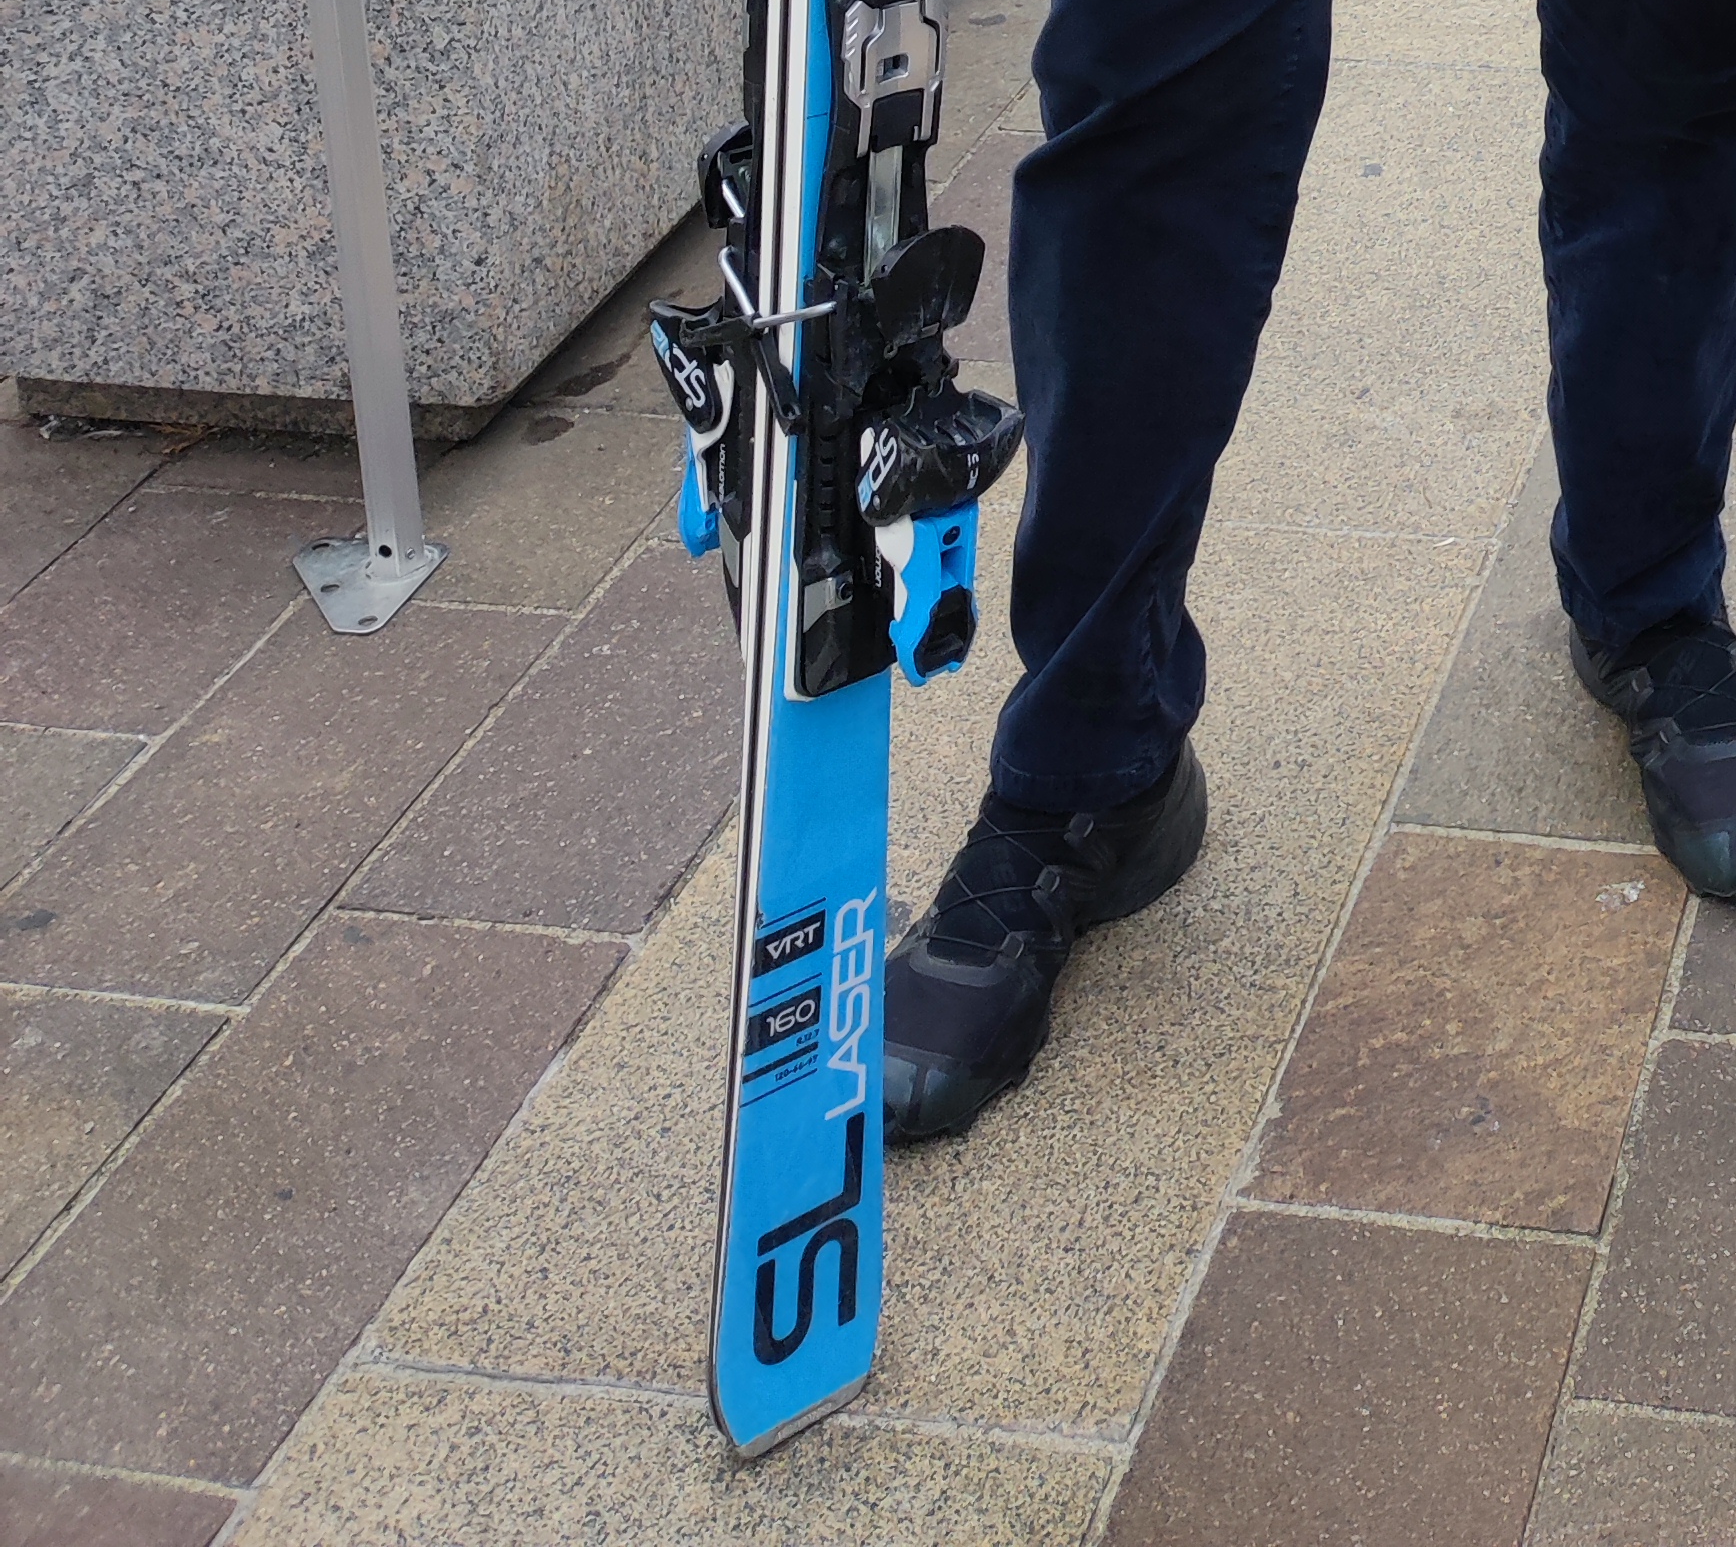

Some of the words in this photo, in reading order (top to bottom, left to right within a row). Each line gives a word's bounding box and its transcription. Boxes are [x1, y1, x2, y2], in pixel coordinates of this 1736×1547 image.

[765, 921, 821, 960] VRT
[824, 885, 878, 1121] LASER
[765, 998, 816, 1038] 160
[753, 1110, 866, 1366] SL
